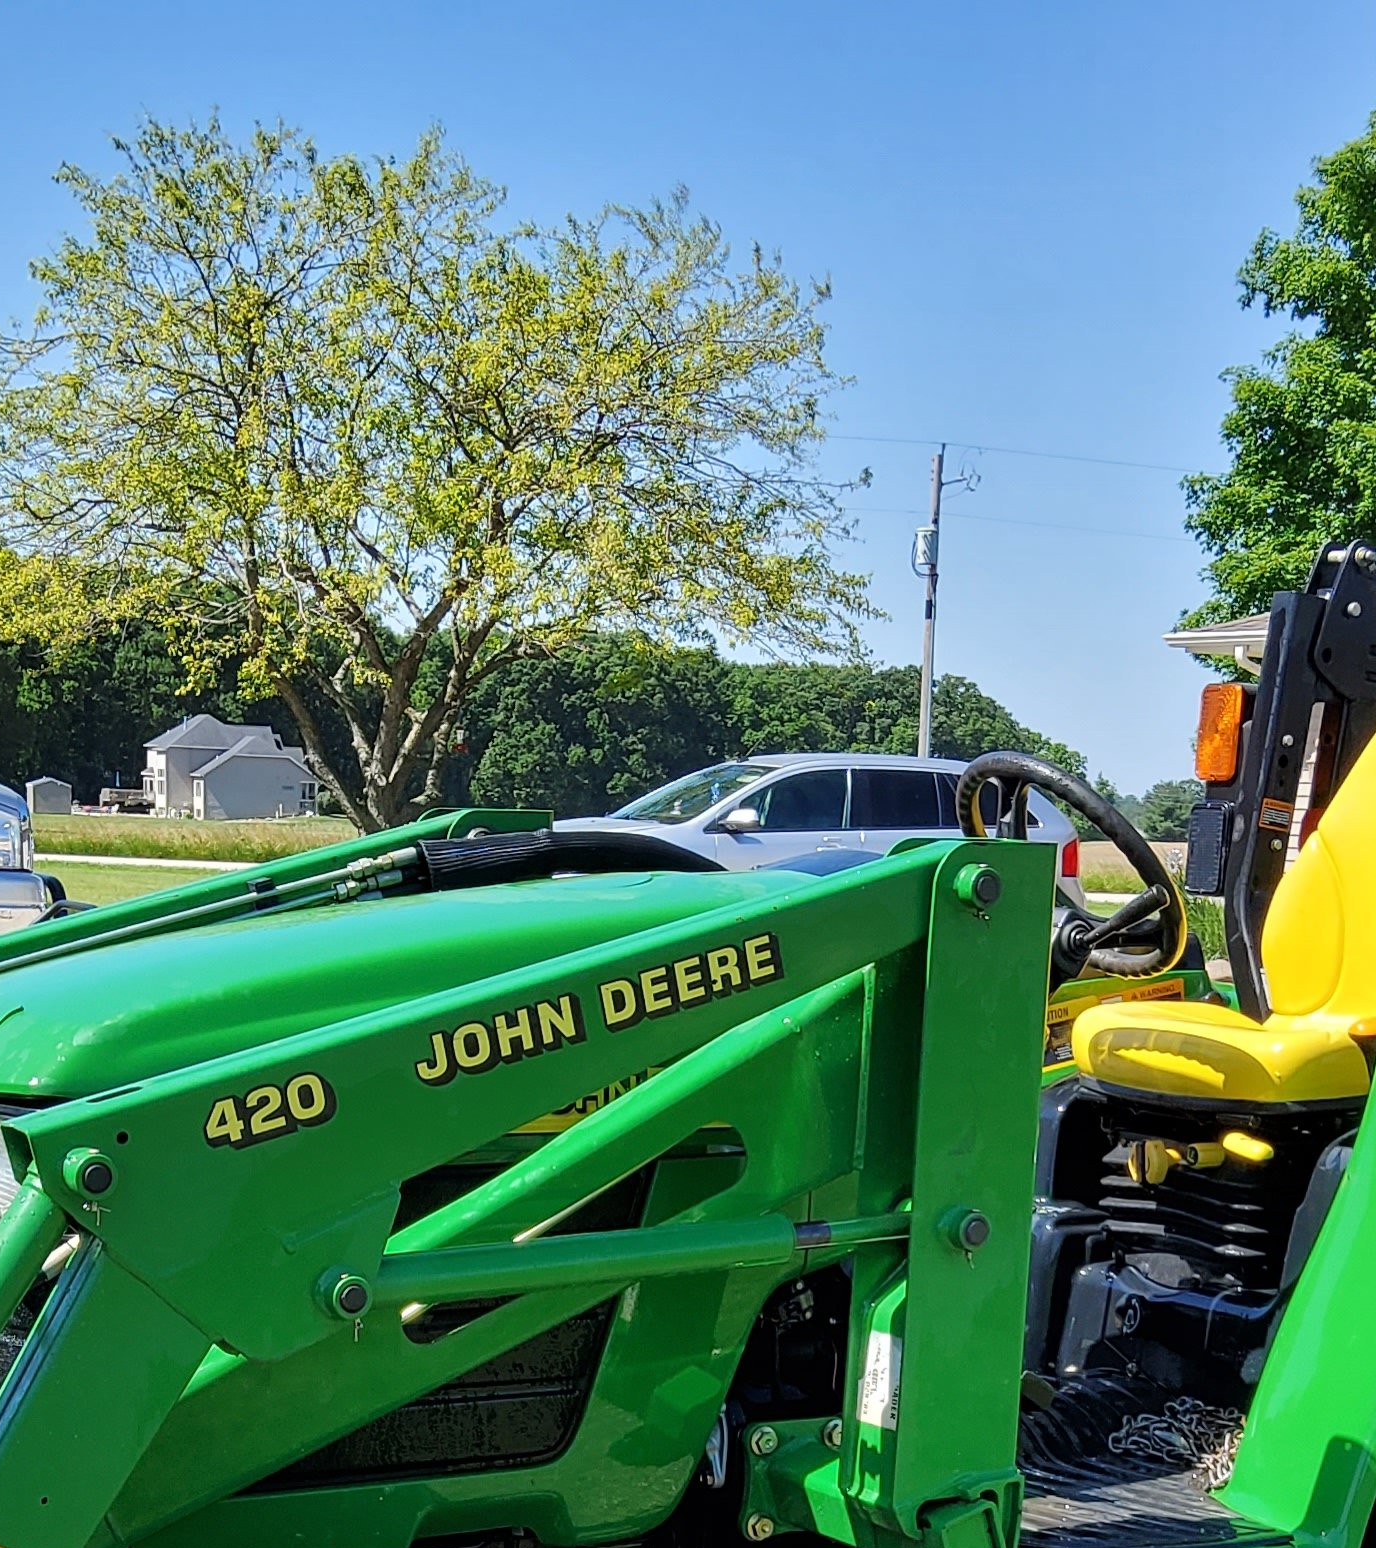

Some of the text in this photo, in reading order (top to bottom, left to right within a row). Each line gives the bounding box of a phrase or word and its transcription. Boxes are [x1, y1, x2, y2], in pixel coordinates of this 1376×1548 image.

[416, 933, 780, 1084] JOHN DEERE
[1046, 1007, 1069, 1021] UTION
[1139, 984, 1176, 999] WARNING
[205, 1072, 332, 1147] 420
